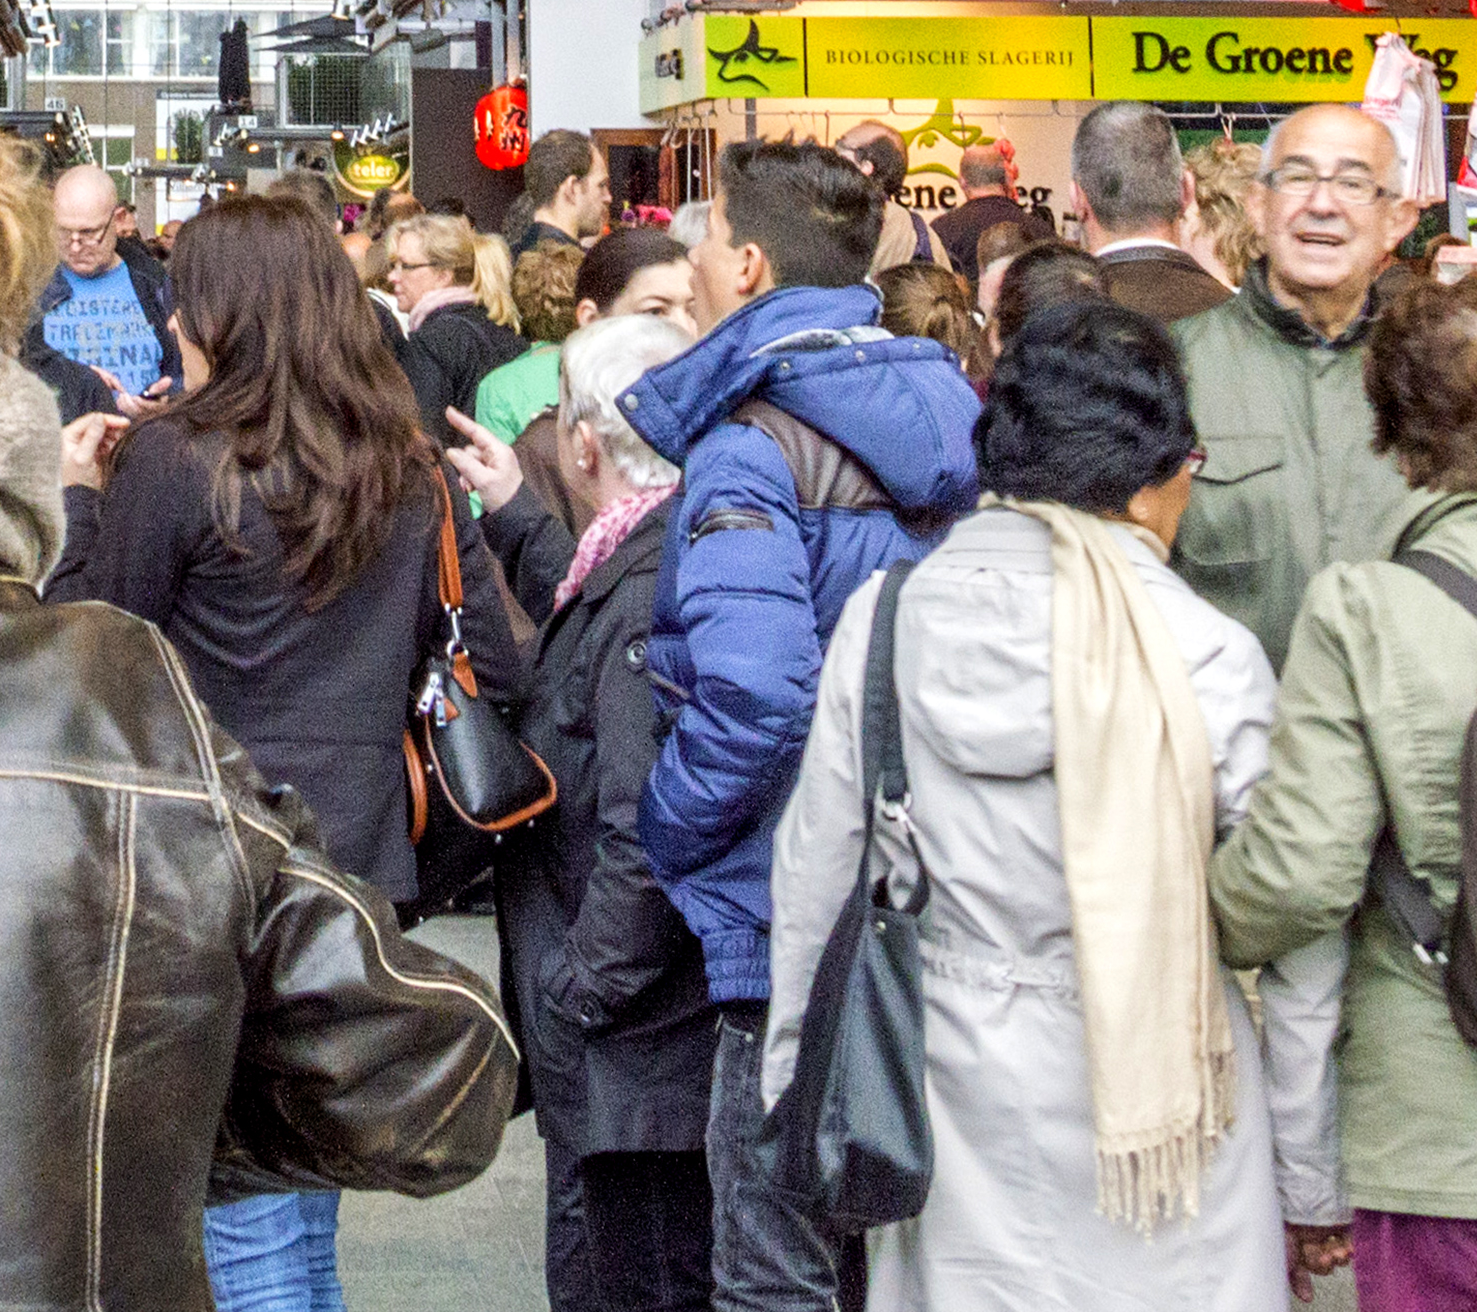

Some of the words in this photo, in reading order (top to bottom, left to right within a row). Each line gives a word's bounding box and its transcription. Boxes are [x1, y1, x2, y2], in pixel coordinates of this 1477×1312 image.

[826, 49, 971, 66] BIOLOGISCHE
[978, 49, 1074, 67] SLAGERIJ
[1131, 32, 1192, 74] De
[1205, 31, 1354, 74] Groene
